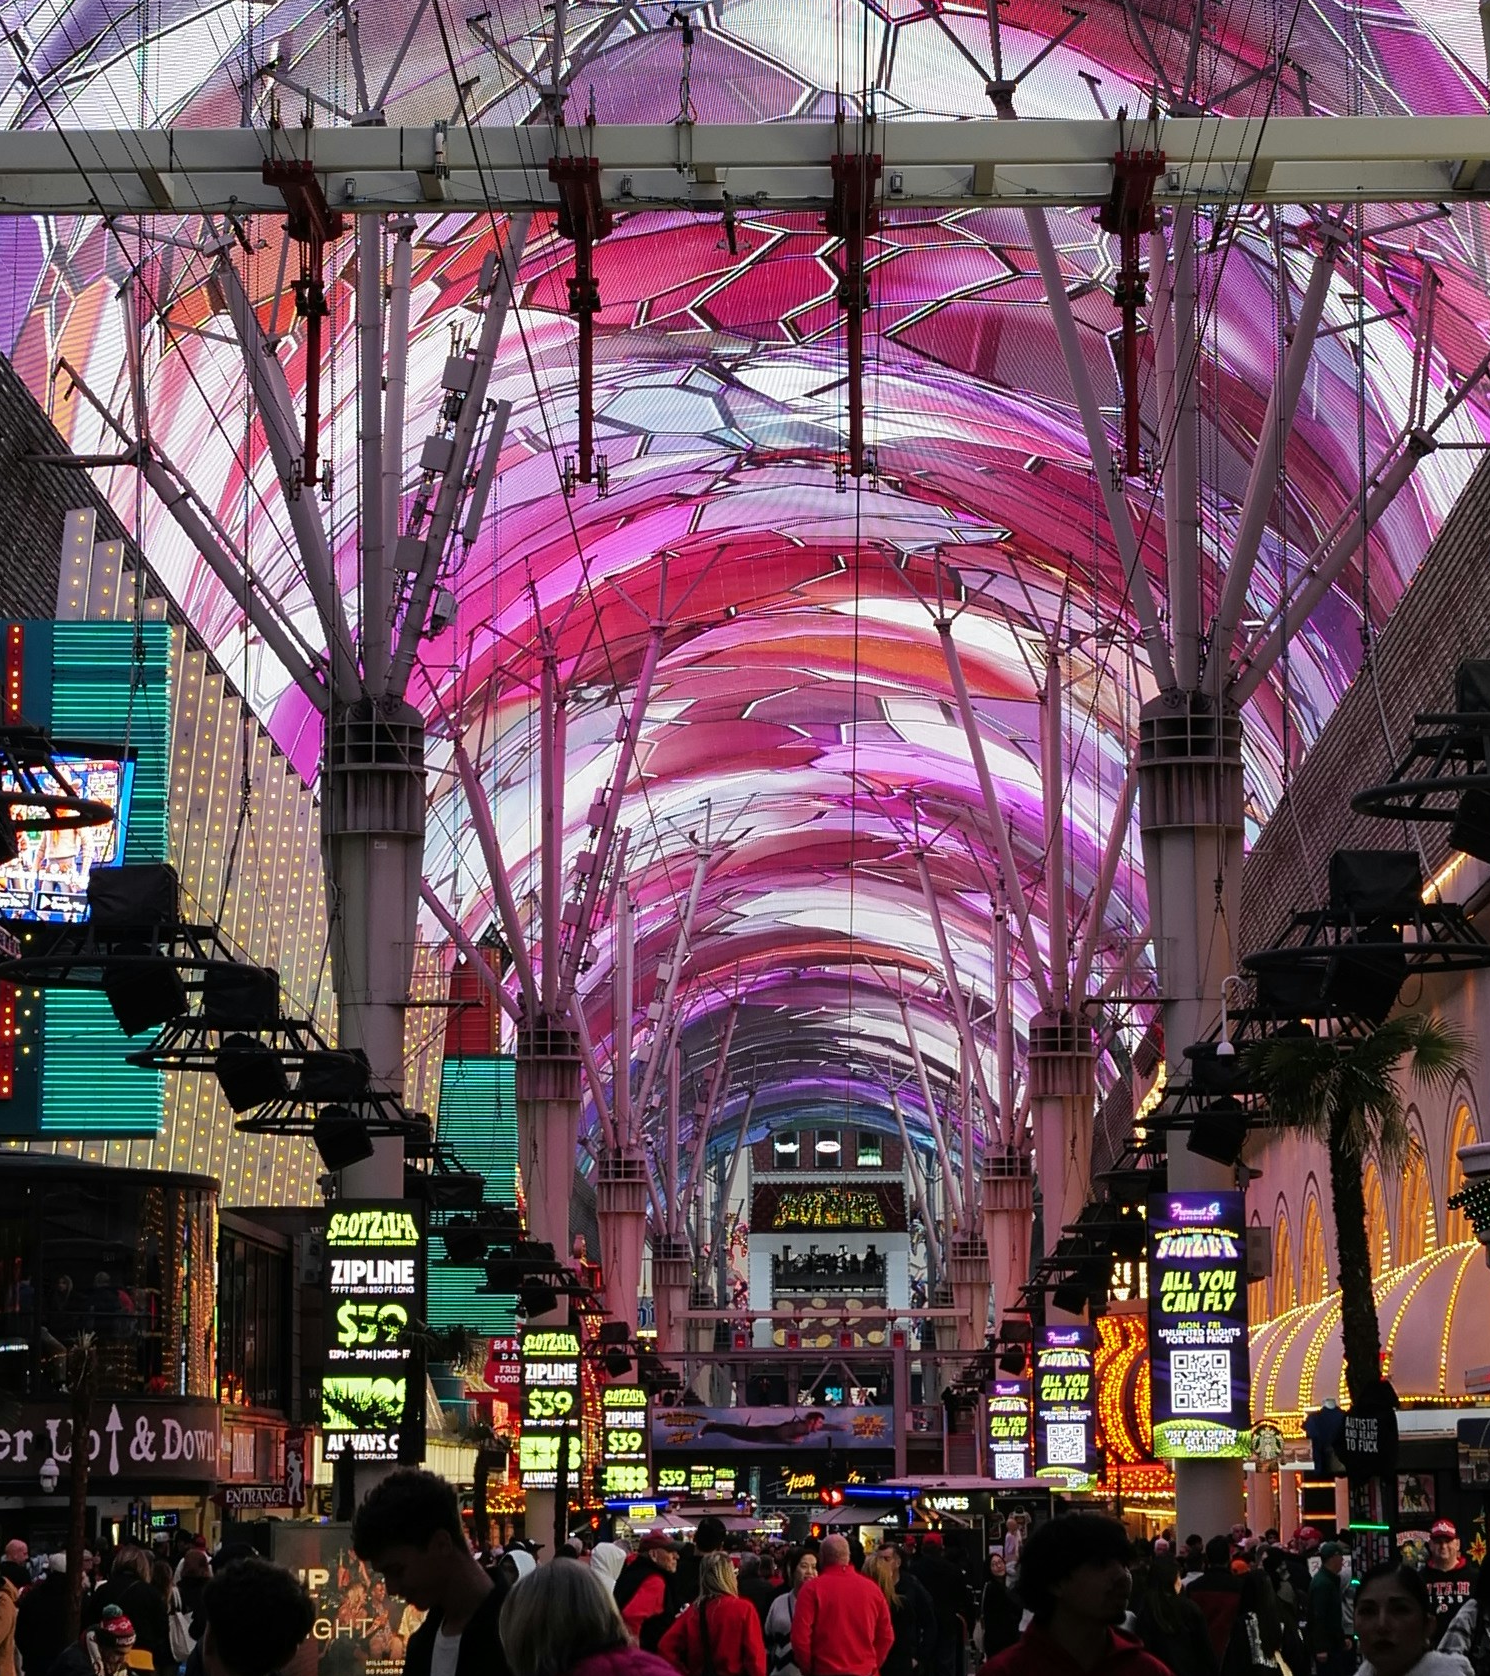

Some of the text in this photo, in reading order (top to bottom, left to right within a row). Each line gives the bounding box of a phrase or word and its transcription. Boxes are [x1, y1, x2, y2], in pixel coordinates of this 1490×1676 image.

[326, 1211, 419, 1240] SLOTZILLA
[1156, 1235, 1237, 1259] SLOTZILLA
[331, 1260, 414, 1284] ZIPLINE
[1160, 1270, 1236, 1292] ALL YOU
[1162, 1292, 1236, 1313] CAN FLY
[1178, 1321, 1220, 1329] MON FRI
[1158, 1328, 1241, 1338] UNLIMITED FLIGHTS
[1166, 1336, 1183, 1344] FOR
[1184, 1336, 1205, 1344] ONE
[525, 1364, 577, 1379] ZIPLINE
[494, 1375, 520, 1383] FOOD
[1041, 1374, 1089, 1388] ALL YOU
[1041, 1388, 1065, 1401] CAN
[1067, 1388, 1089, 1400] FLY
[529, 1388, 573, 1419] $39
[605, 1411, 645, 1425] ZIPLINE
[991, 1417, 1027, 1427] ALL YOU
[1345, 1417, 1378, 1428] AUTISTIC
[129, 1416, 157, 1462] &
[162, 1418, 215, 1462] Down
[1011, 1427, 1027, 1437] FLY
[1164, 1429, 1237, 1438] VISIT BOX OFFICE
[1345, 1430, 1378, 1441] AND READY
[608, 1430, 643, 1453] $39
[1169, 1437, 1236, 1446] OR GET TICKETS
[1186, 1444, 1219, 1452] ONLINE
[1346, 1439, 1378, 1453] TO FUCK
[659, 1468, 686, 1486] $39
[226, 1488, 286, 1504] ENTRANCE
[934, 1498, 969, 1509] VAPES
[306, 1618, 374, 1639] GHT
